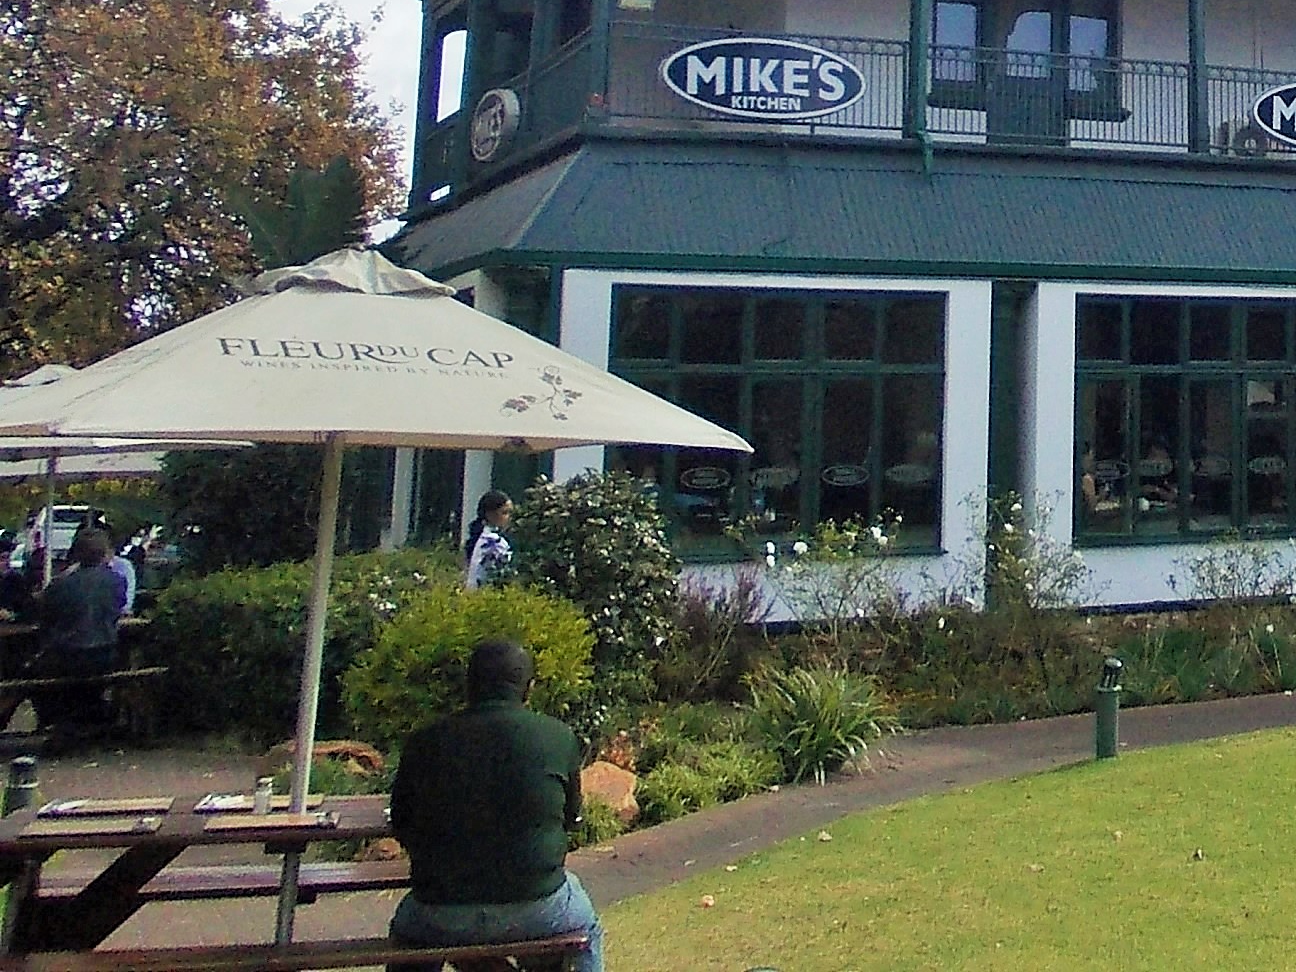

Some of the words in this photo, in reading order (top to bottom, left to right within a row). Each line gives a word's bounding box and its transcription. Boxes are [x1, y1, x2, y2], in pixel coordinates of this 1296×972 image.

[686, 54, 846, 101] MIKE'S
[731, 95, 801, 111] KITCHEN
[216, 337, 402, 363] FLEUR
[376, 345, 419, 358] DU
[426, 348, 514, 369] CAP
